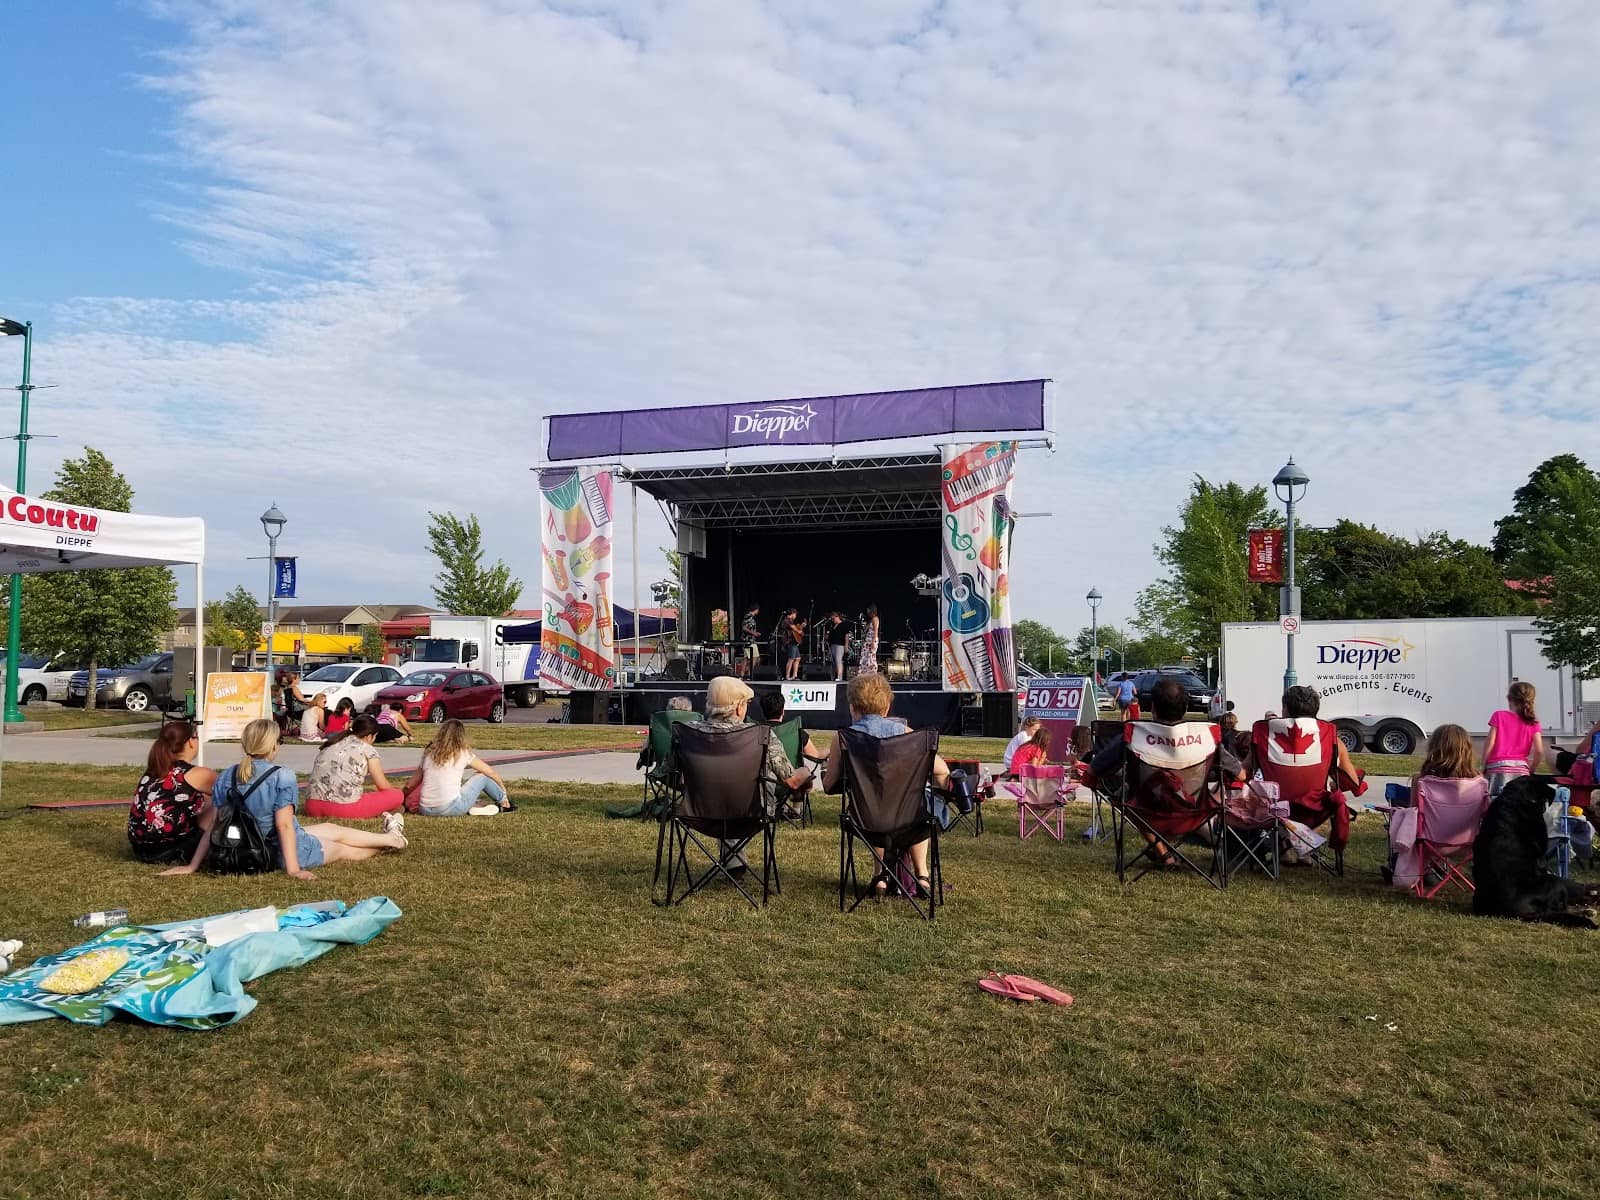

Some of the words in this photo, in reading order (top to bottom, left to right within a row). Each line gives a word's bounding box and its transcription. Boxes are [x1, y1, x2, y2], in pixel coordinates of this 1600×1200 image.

[731, 413, 804, 439] Dieppe
[8, 496, 98, 532] Coutu
[56, 535, 93, 547] DIEPPE
[1316, 643, 1401, 671] Dieppe
[1392, 682, 1433, 704] Events
[1146, 734, 1202, 748] CANADA
